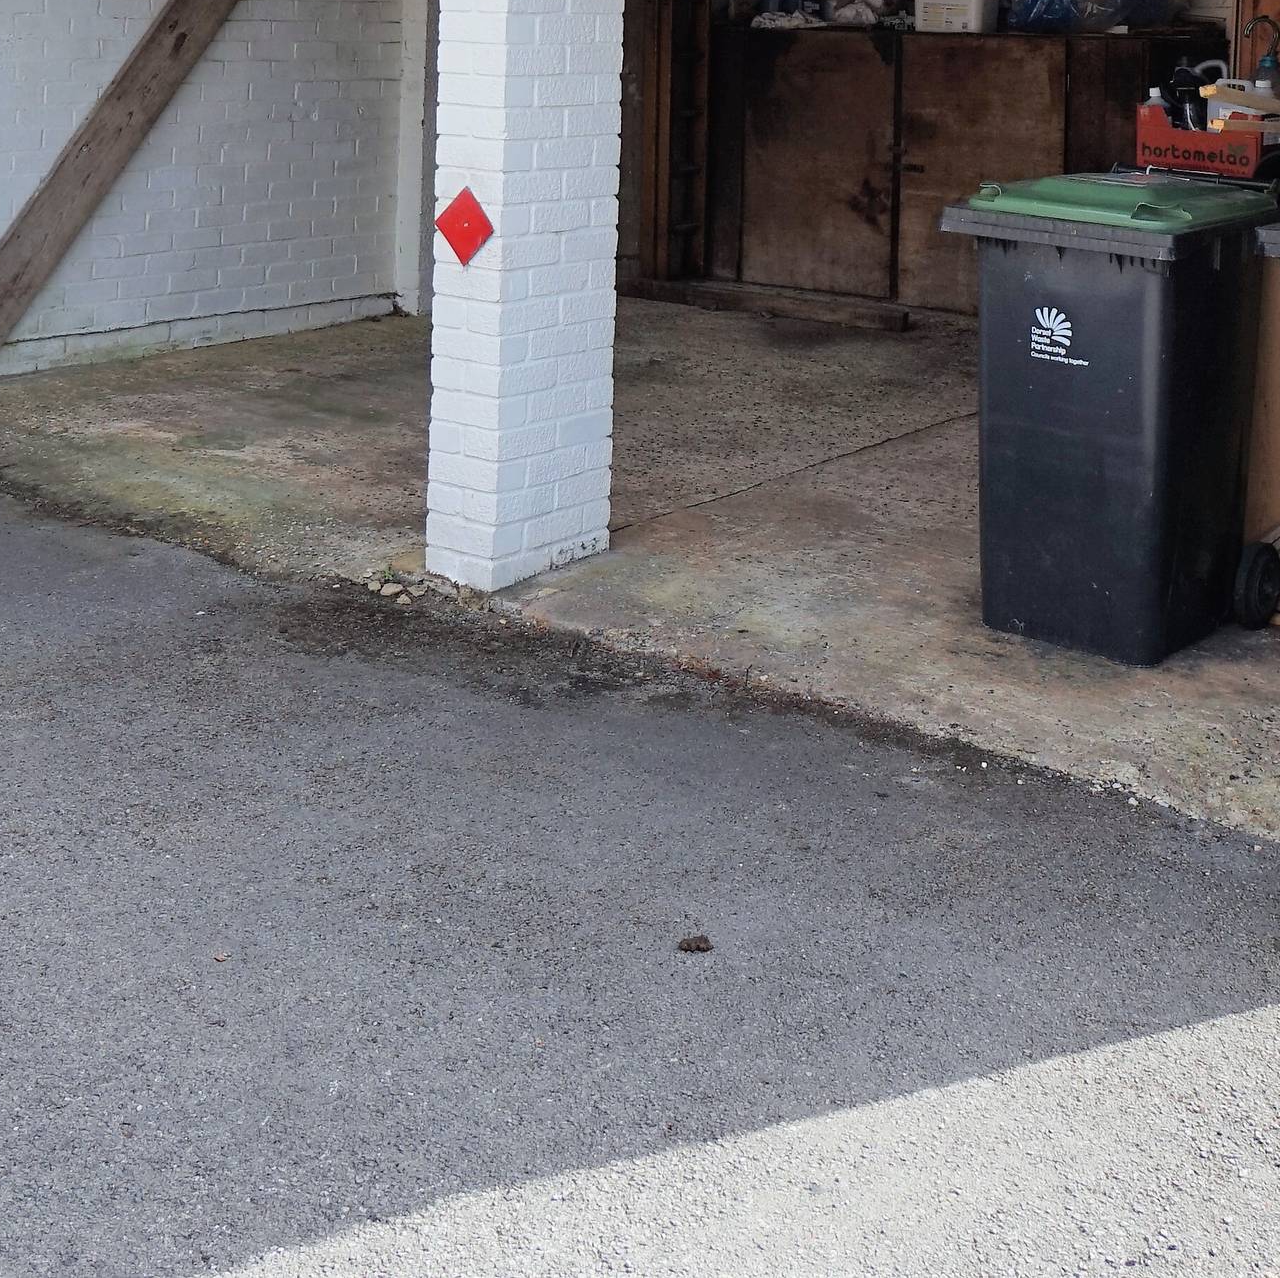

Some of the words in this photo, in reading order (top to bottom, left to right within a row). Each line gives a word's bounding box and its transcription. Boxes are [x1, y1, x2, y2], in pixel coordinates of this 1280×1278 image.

[1031, 326, 1051, 336] Dorset
[1031, 334, 1050, 343] Waste
[1031, 341, 1066, 355] Partnership
